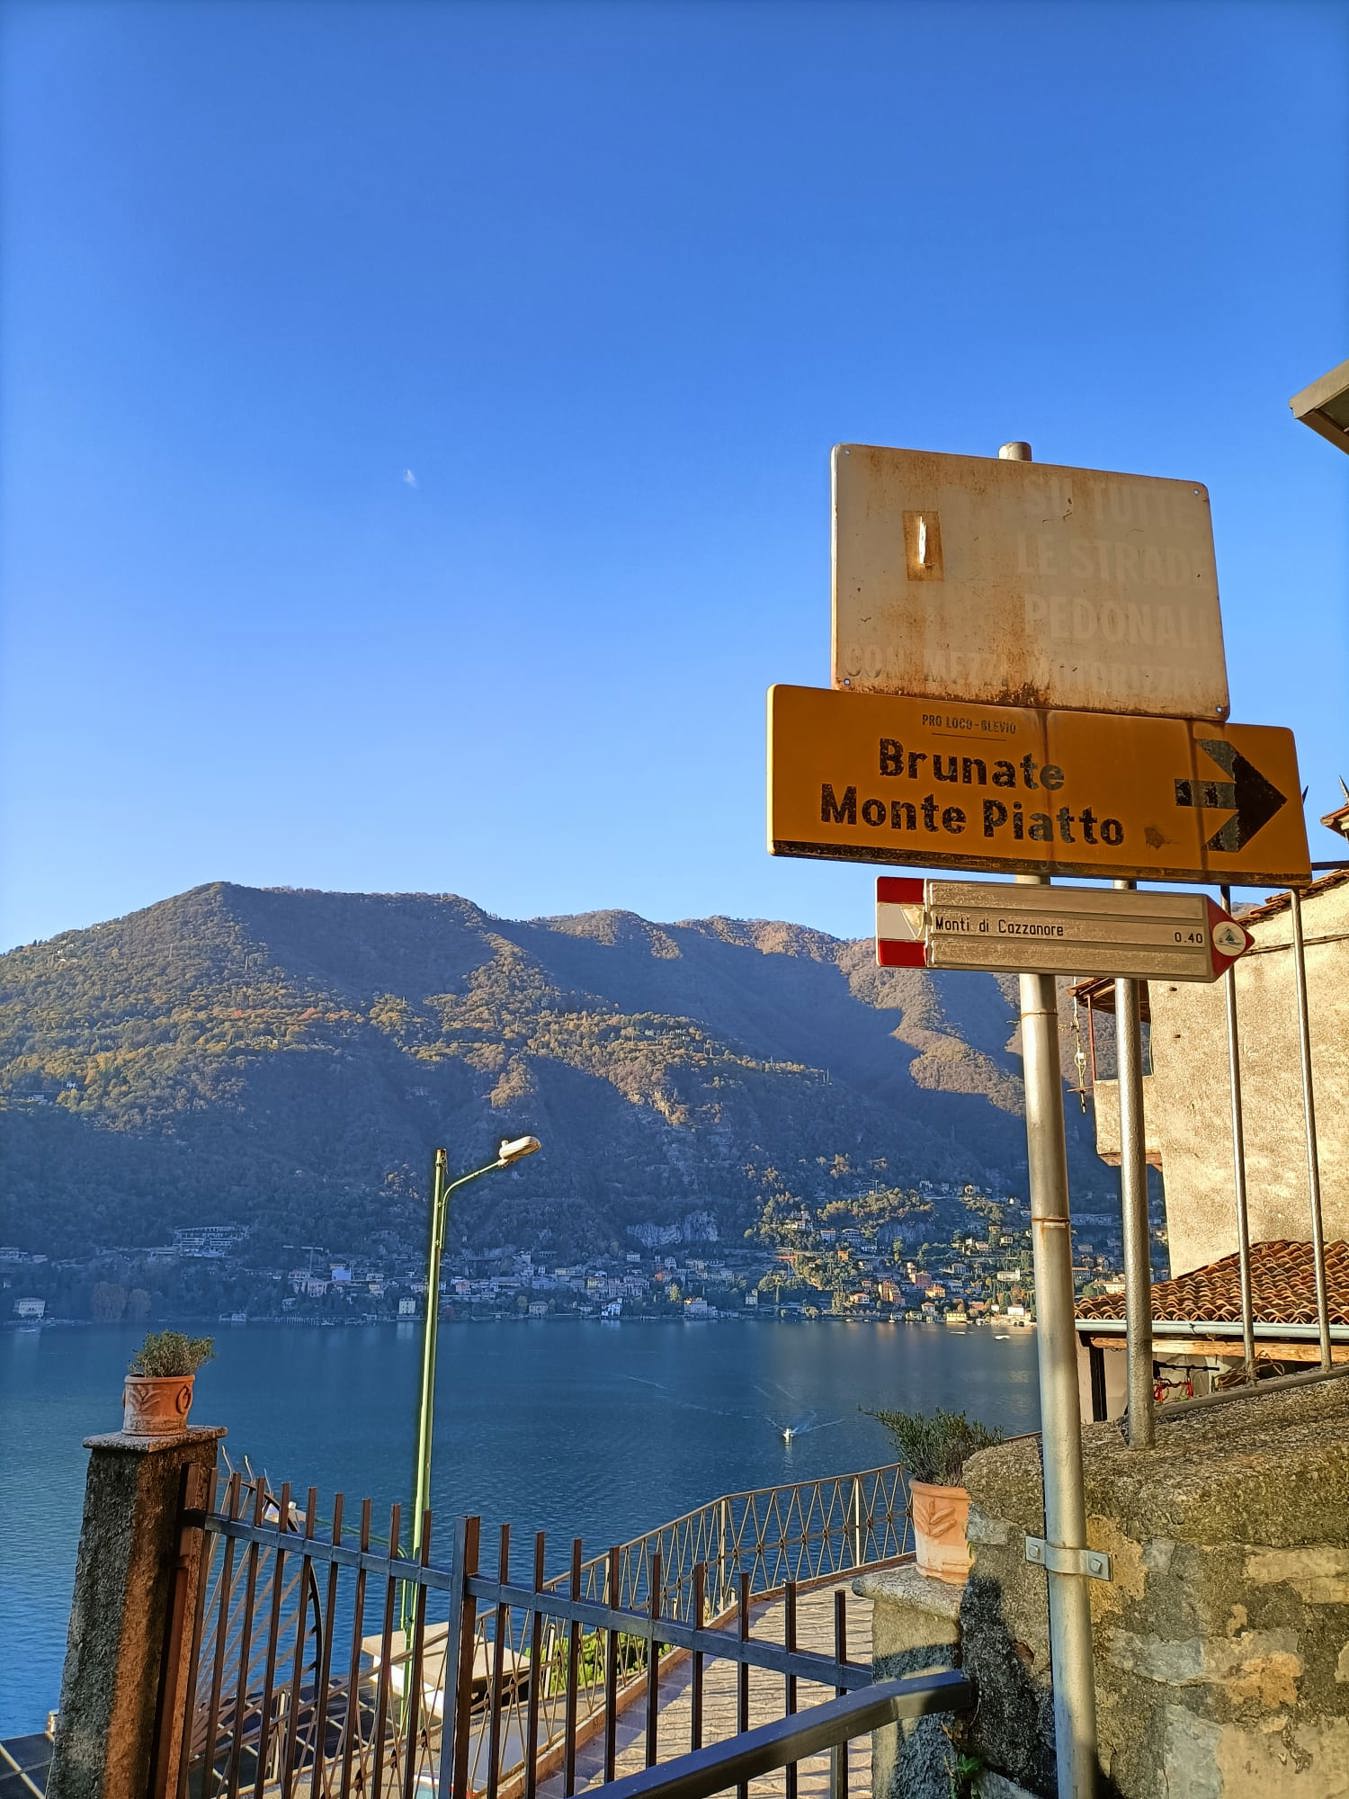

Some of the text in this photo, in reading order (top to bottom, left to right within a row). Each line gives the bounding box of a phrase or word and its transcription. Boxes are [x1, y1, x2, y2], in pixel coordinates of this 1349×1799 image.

[922, 714, 942, 727] PRO
[879, 738, 1065, 791] Brunate
[820, 783, 1124, 846] Monte Piatto
[935, 916, 970, 932] Monti
[979, 919, 989, 932] di
[1174, 932, 1203, 943] 0.40
